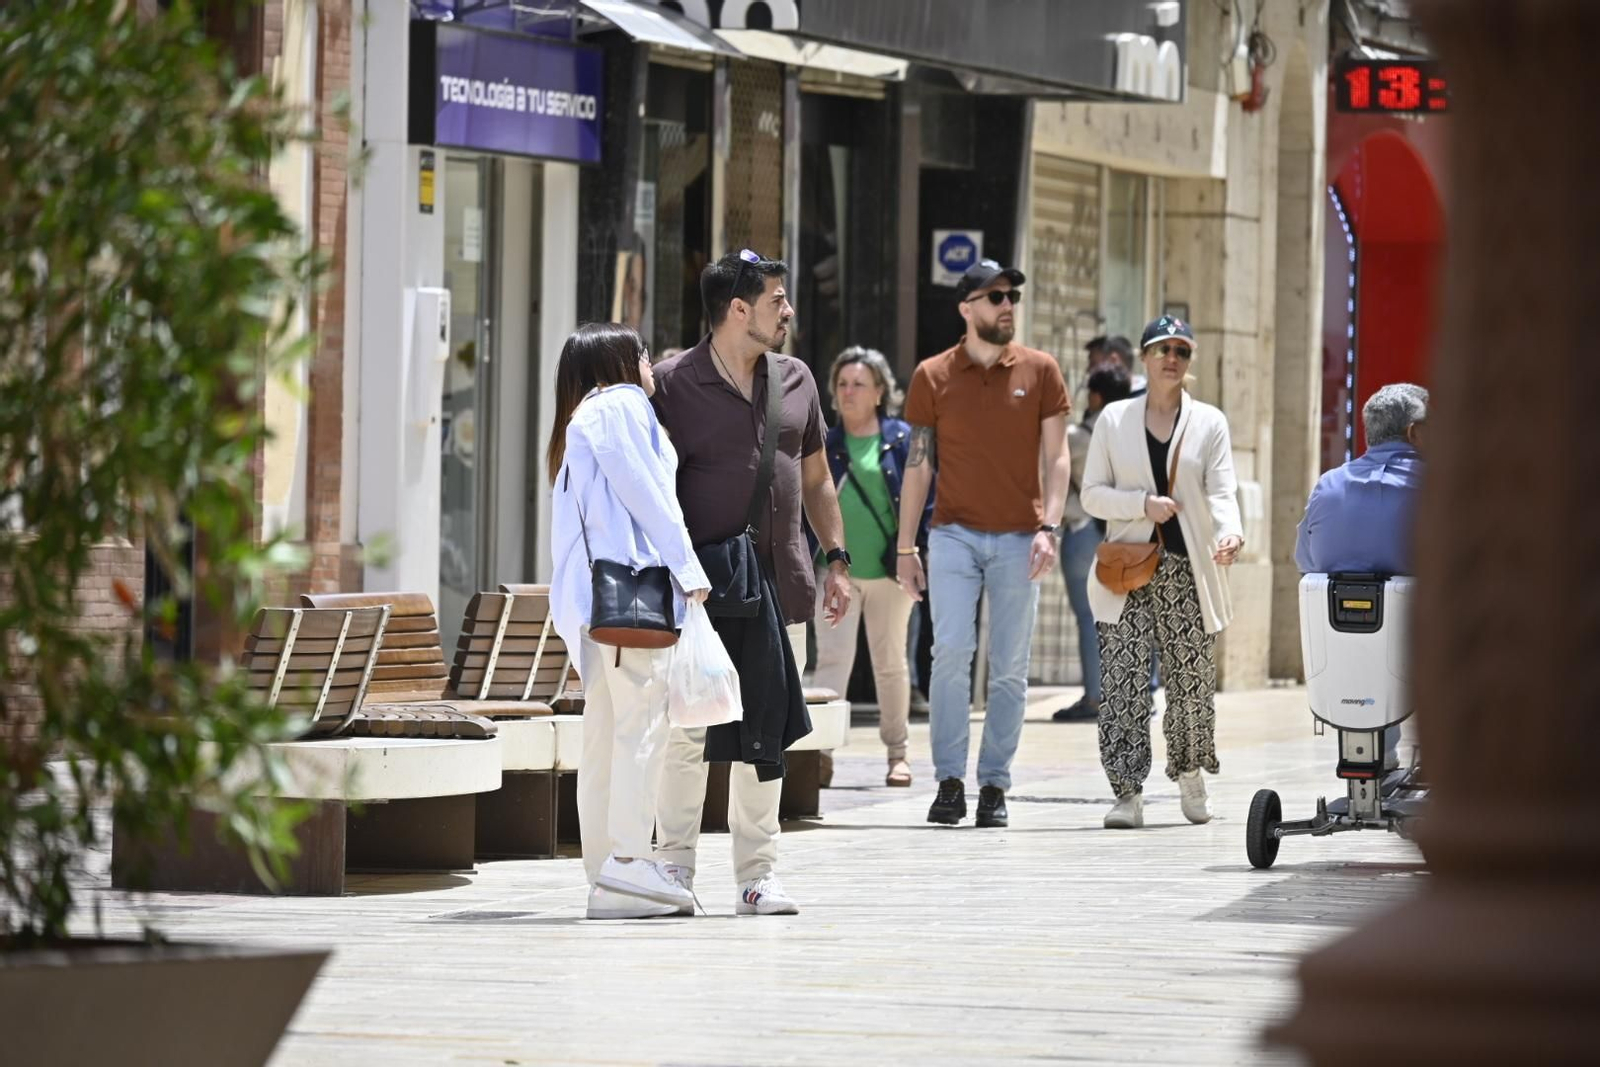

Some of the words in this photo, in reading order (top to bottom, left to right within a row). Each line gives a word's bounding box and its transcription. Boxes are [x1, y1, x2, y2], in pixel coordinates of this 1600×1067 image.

[527, 88, 546, 114] TU
[546, 90, 596, 120] SERVICIO
[1345, 66, 1446, 109] 13:
